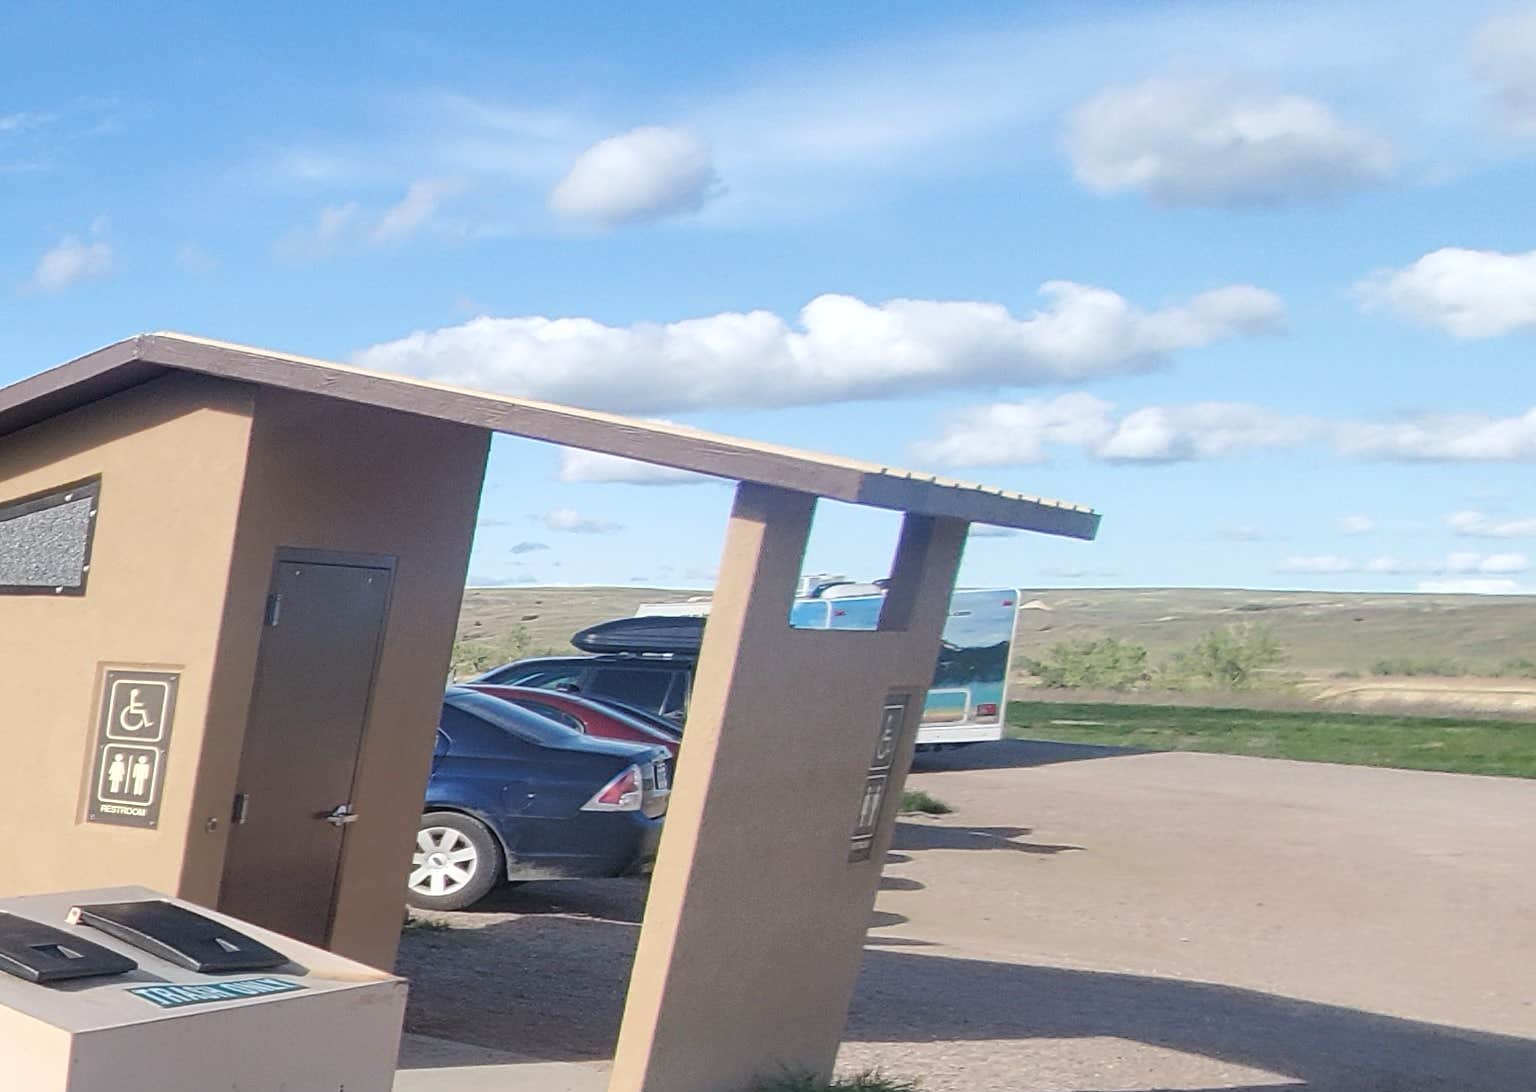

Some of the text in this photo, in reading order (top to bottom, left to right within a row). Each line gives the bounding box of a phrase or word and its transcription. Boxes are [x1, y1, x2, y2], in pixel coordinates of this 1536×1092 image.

[100, 805, 147, 816] RESTROOM
[134, 978, 297, 1004] TRASH ONLY
